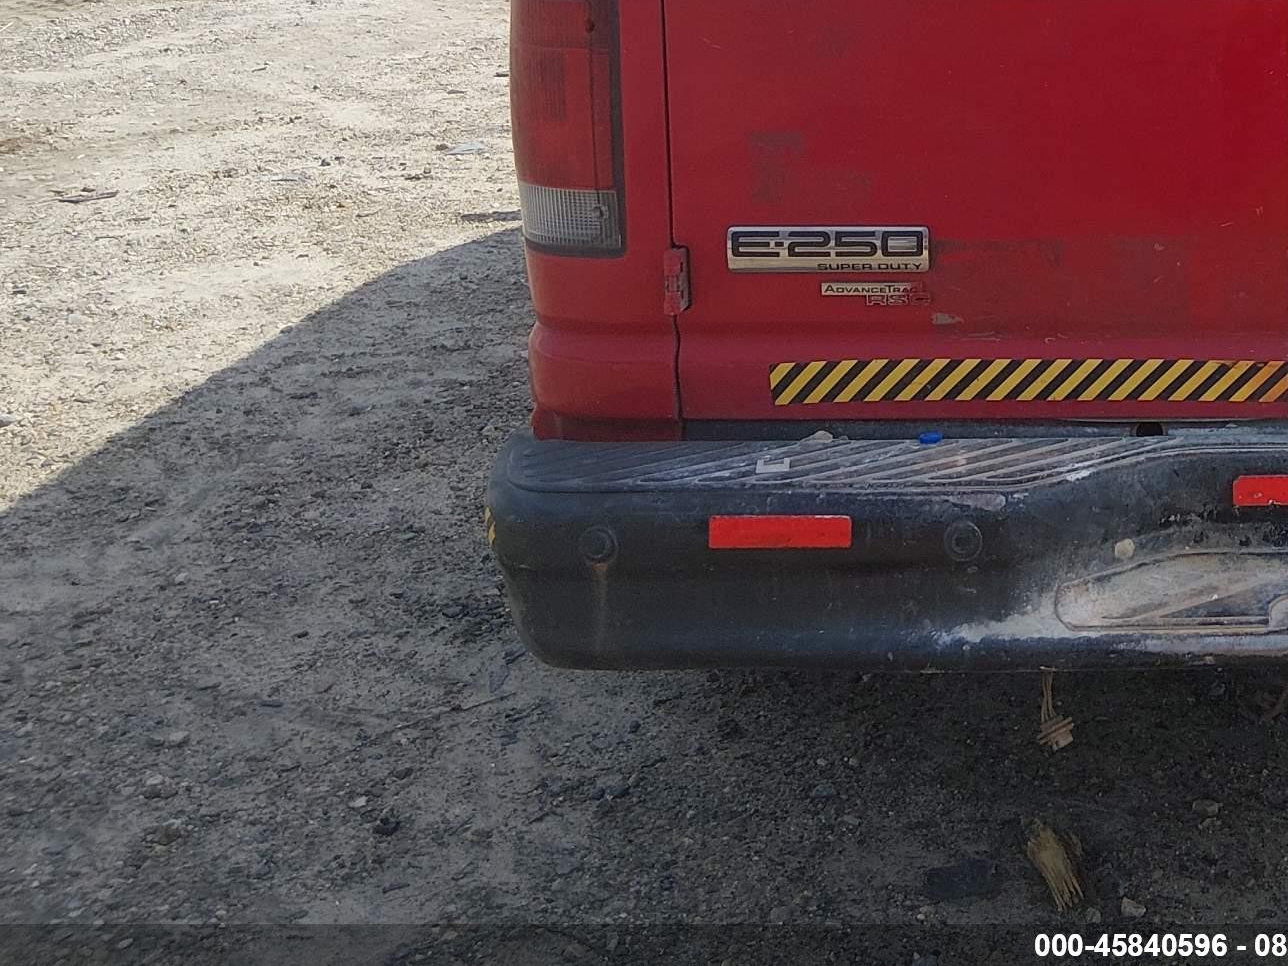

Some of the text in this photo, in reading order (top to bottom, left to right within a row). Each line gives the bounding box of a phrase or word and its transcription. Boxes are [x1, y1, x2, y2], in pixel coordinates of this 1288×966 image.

[731, 231, 924, 258] E-250
[817, 263, 922, 271] SUPER DUTY
